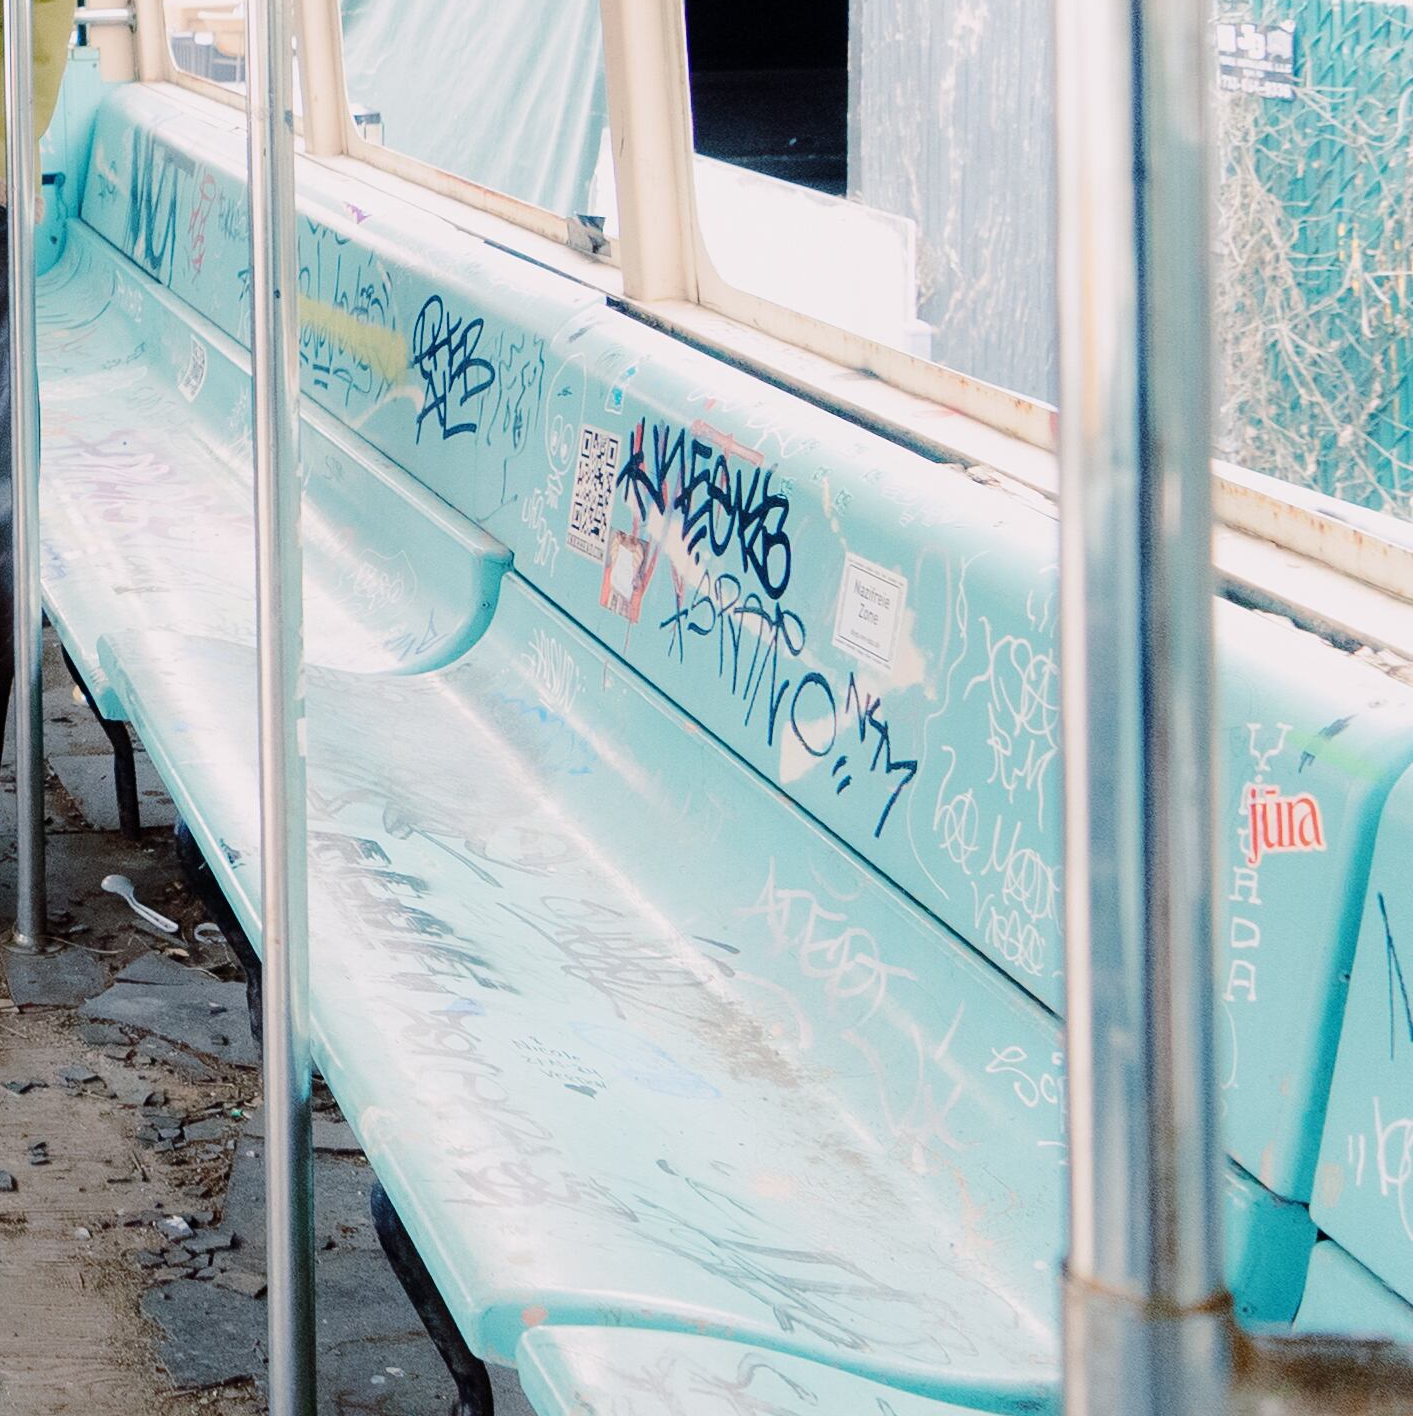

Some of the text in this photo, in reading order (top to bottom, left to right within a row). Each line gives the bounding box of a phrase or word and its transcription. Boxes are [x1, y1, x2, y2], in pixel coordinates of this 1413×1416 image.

[853, 578, 891, 611] Nazifreie
[857, 601, 879, 626] Zone
[1246, 788, 1323, 863] jūra
